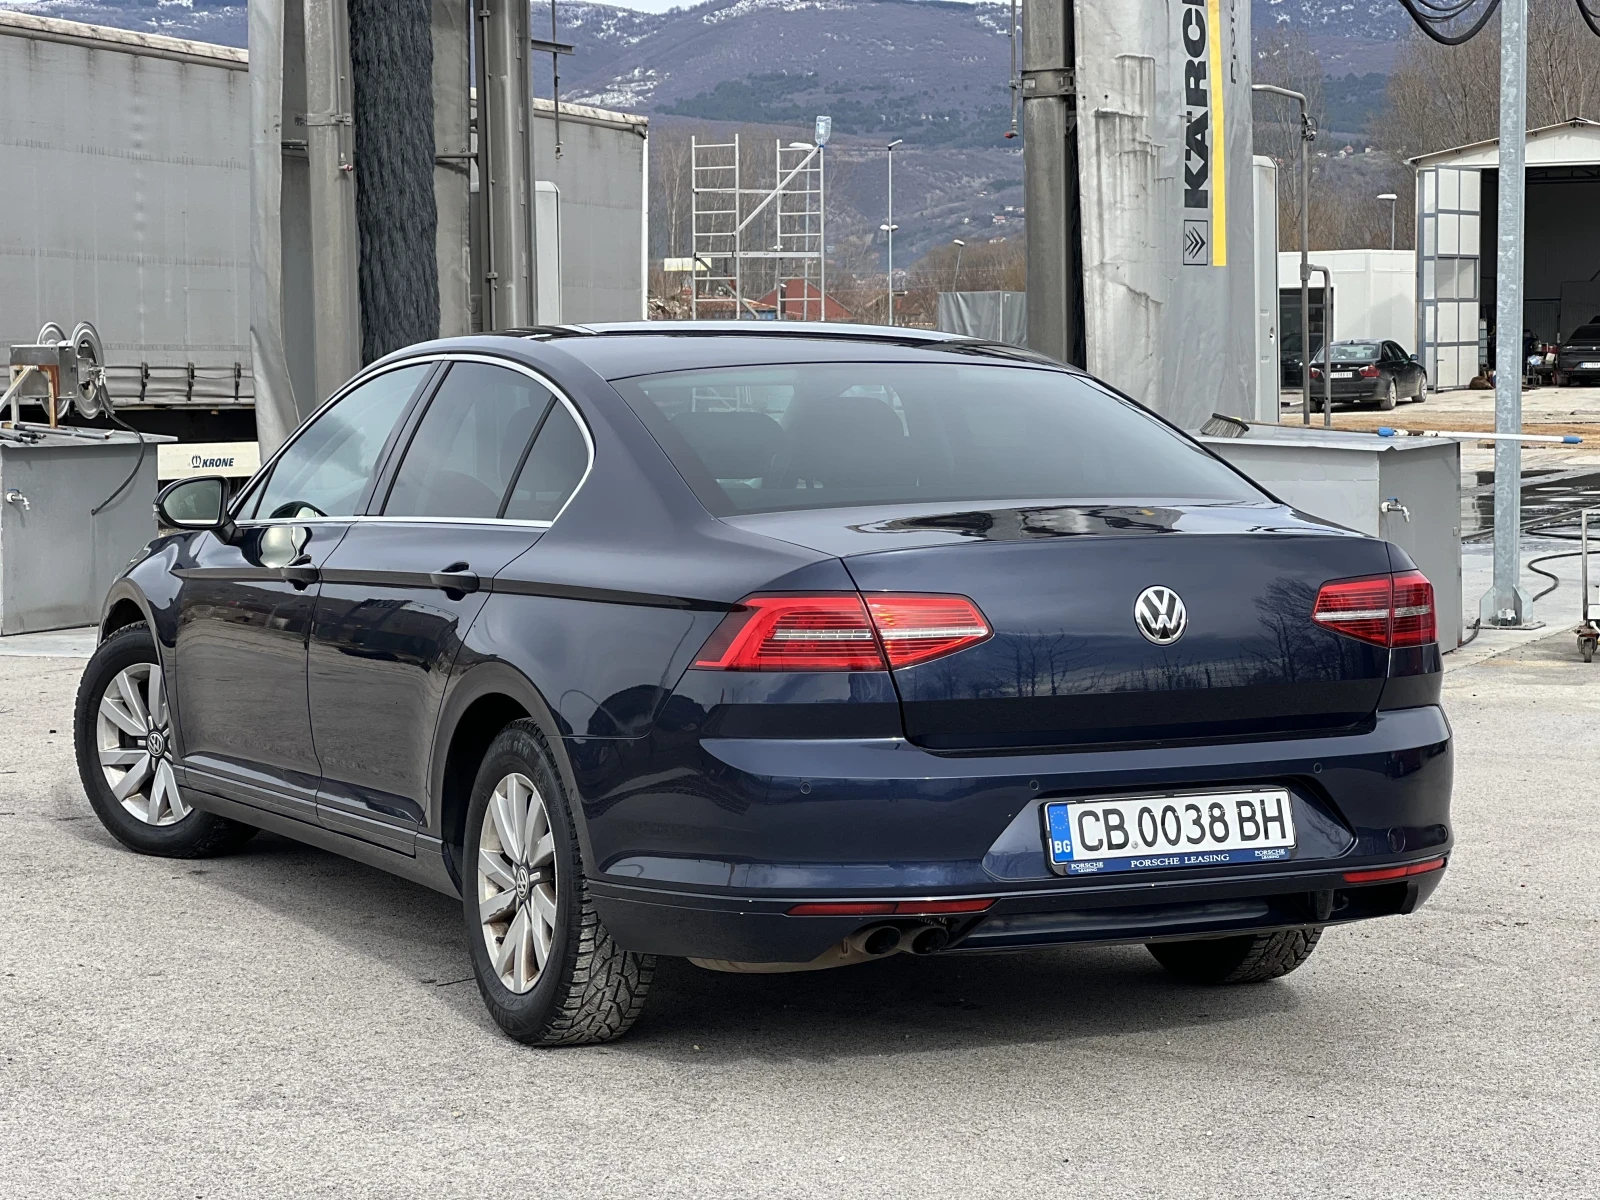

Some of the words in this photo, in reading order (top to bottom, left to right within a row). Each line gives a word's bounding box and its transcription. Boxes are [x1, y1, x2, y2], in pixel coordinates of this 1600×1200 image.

[1181, 0, 1208, 208] KÄRC
[202, 458, 235, 468] KRONE
[1135, 586, 1186, 644] VW
[1077, 808, 1130, 852] CB
[1137, 801, 1230, 847] 0038
[1236, 798, 1287, 842] BH
[1054, 840, 1072, 853] BG
[1254, 849, 1286, 857] PORSCHE
[1070, 861, 1104, 870] PORSCHE
[1130, 857, 1181, 868] PORSCHE
[1184, 853, 1230, 864] LEASING
